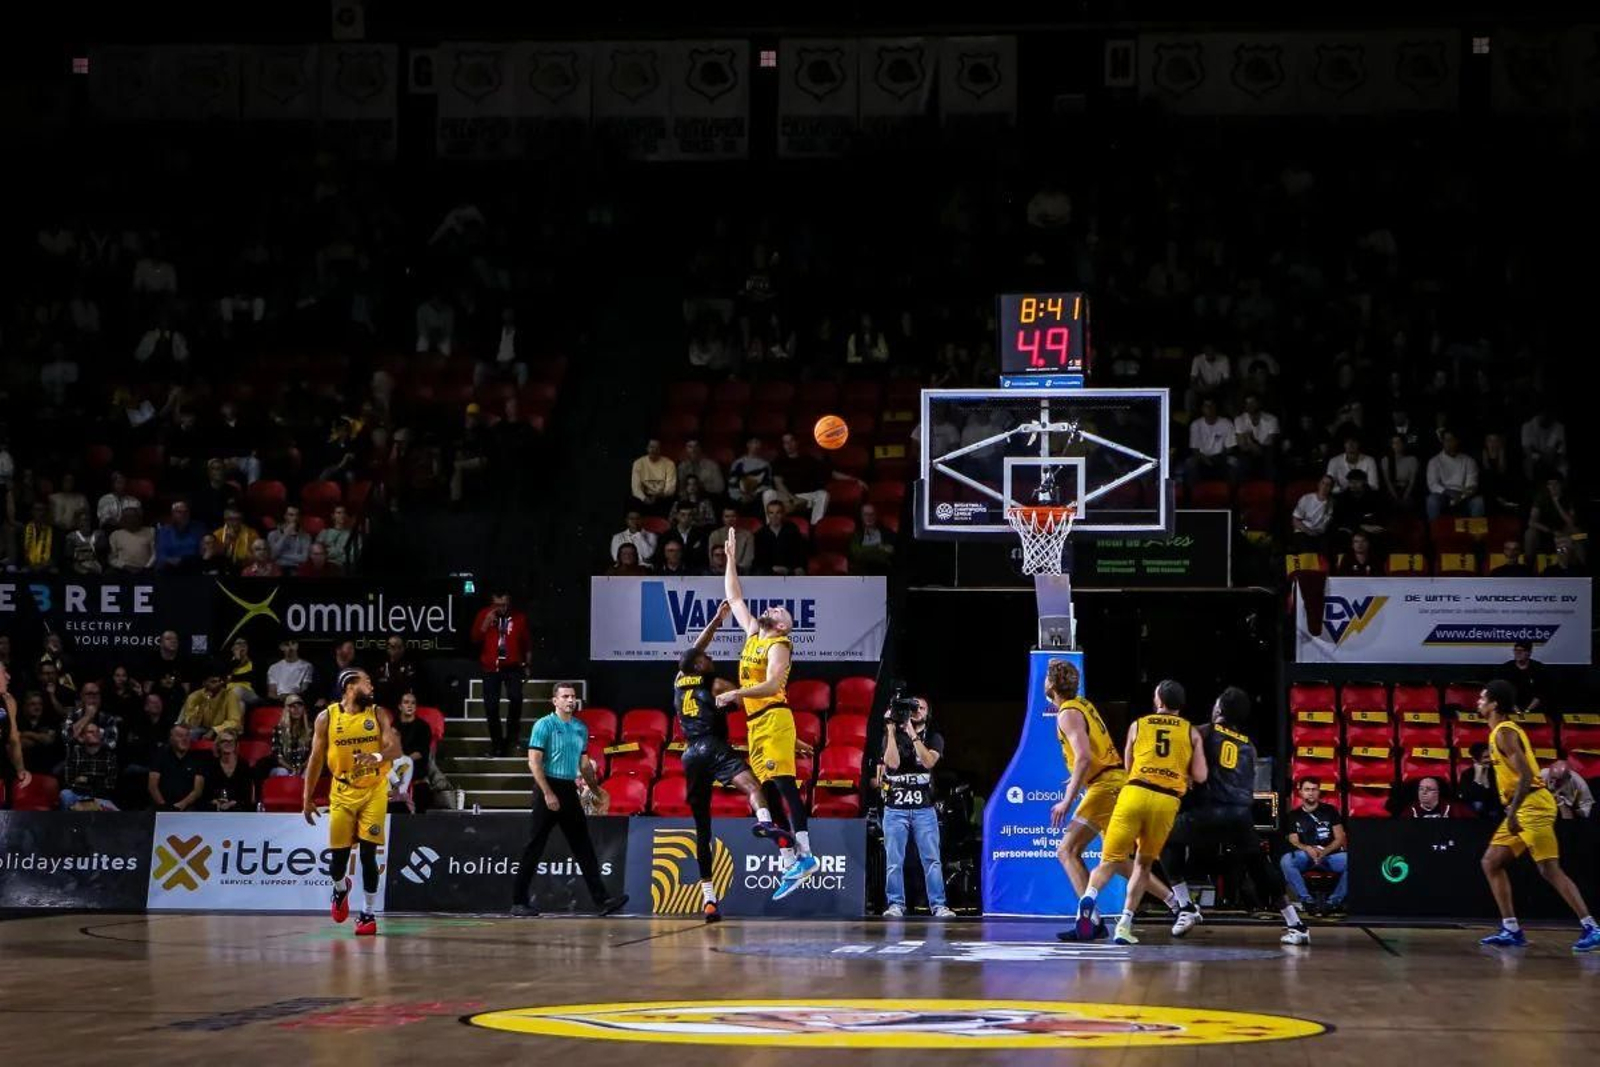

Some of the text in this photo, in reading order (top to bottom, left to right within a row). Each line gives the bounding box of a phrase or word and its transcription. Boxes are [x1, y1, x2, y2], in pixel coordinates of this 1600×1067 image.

[1020, 298, 1080, 323] 8:41
[1017, 327, 1069, 367] 4.9
[1405, 594, 1421, 603] DE
[1425, 594, 1461, 603] WITTE
[286, 593, 457, 633] omnilevel
[66, 621, 132, 631] ELECTRIFY
[1435, 627, 1551, 640] www.dewittevdc.be
[75, 635, 161, 646] YOUR PROJEC
[711, 634, 744, 644] ARTNER
[683, 689, 699, 717] 4
[1155, 729, 1171, 758] 5
[1220, 740, 1238, 769] 0
[894, 790, 923, 805] 249
[1000, 825, 1012, 837] Jij
[1013, 825, 1045, 835] focust
[1032, 837, 1048, 848] wij
[0, 852, 138, 874] lidaysuites
